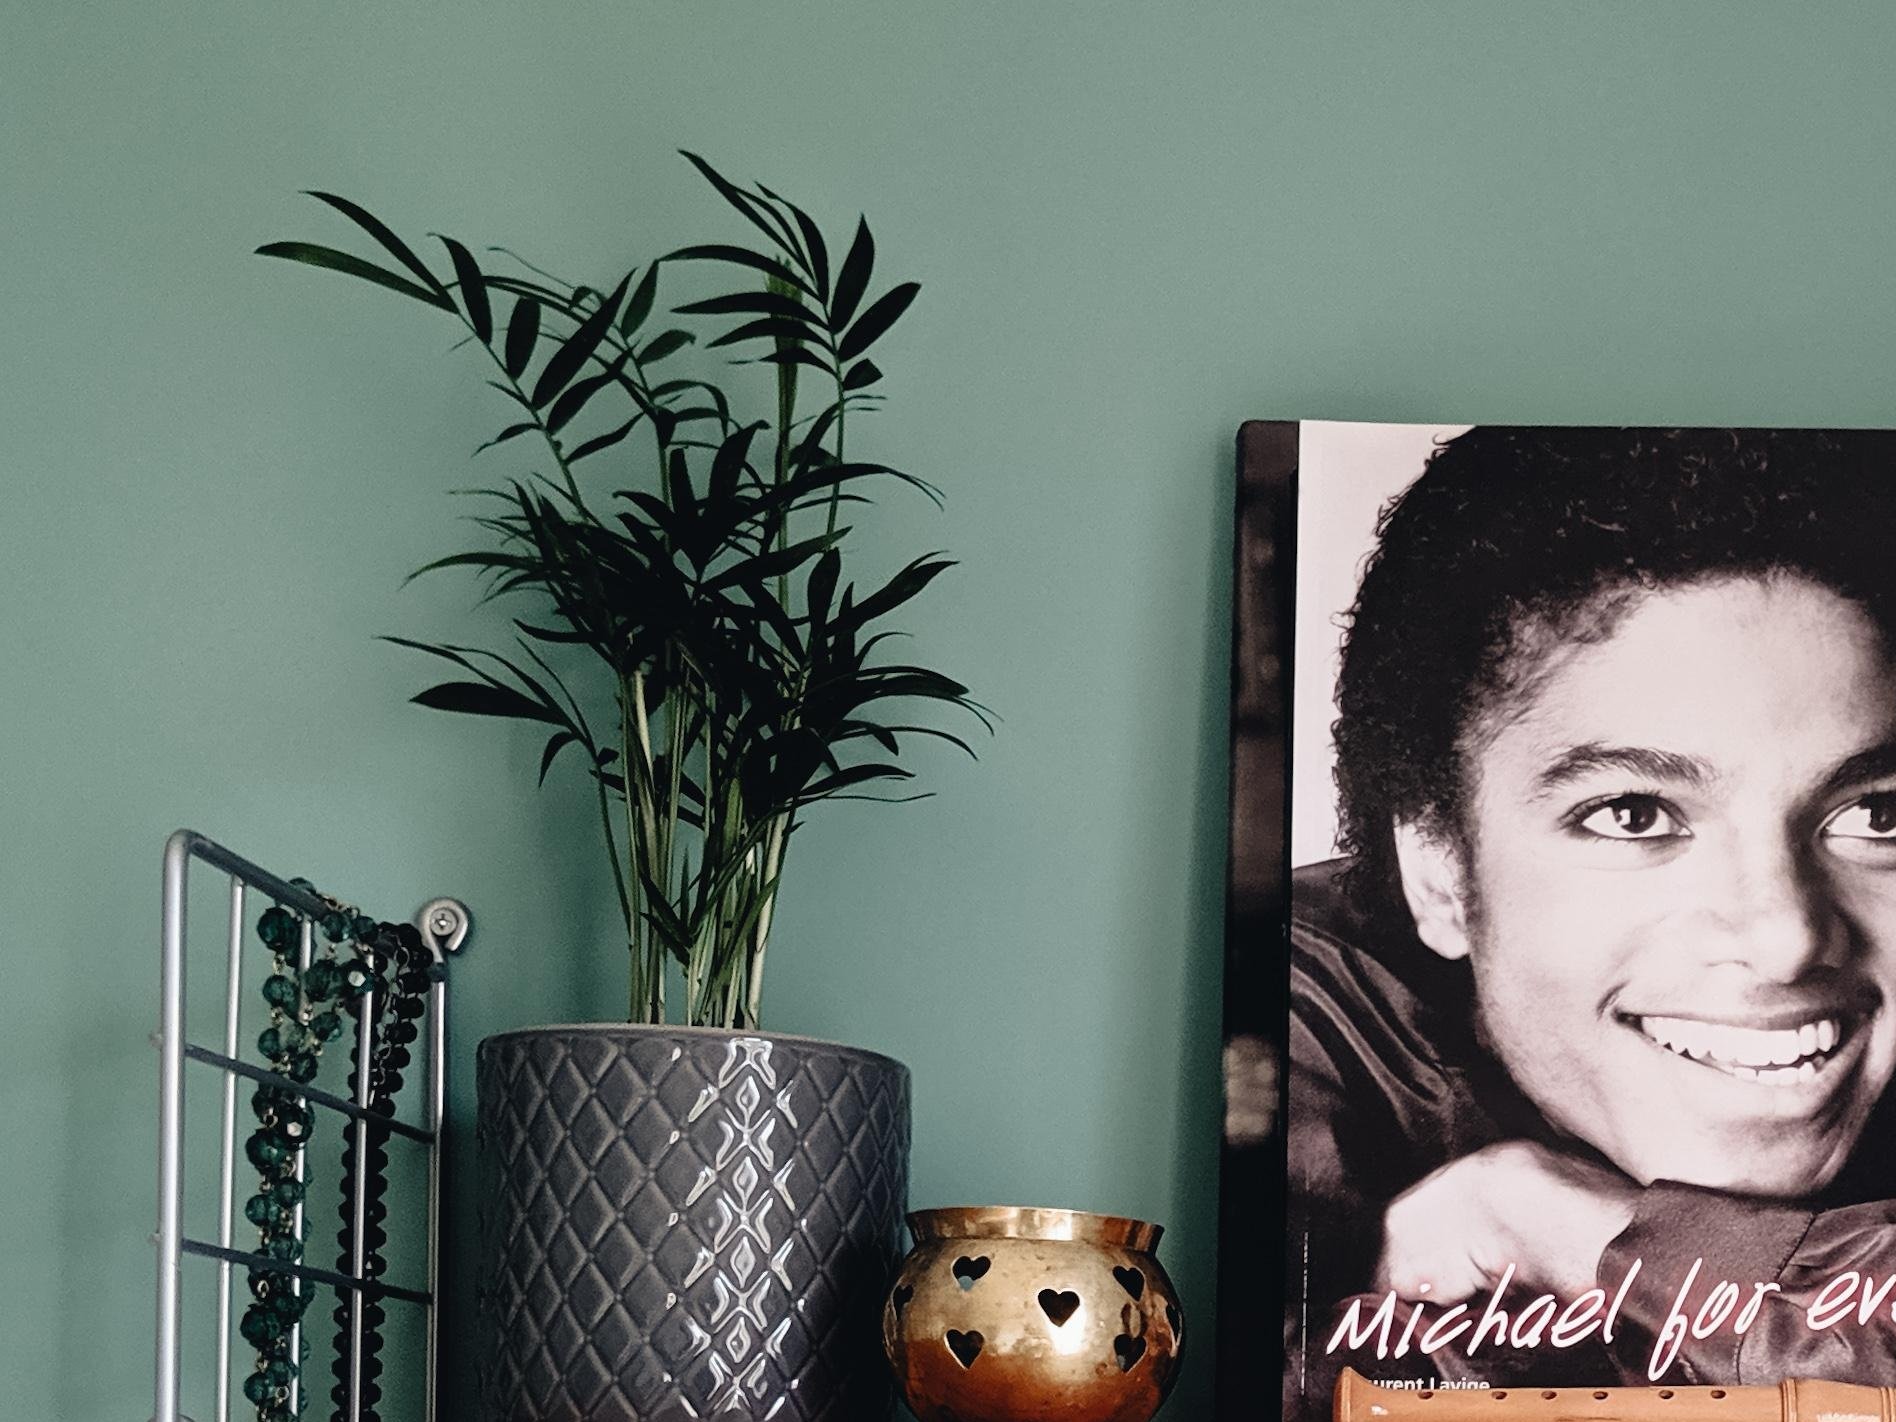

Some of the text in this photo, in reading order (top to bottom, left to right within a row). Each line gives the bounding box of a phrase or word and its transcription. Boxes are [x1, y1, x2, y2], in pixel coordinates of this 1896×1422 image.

[1326, 1258, 1642, 1362] Michael
[1648, 1258, 1782, 1381] for
[1368, 1377, 1424, 1390] urent
